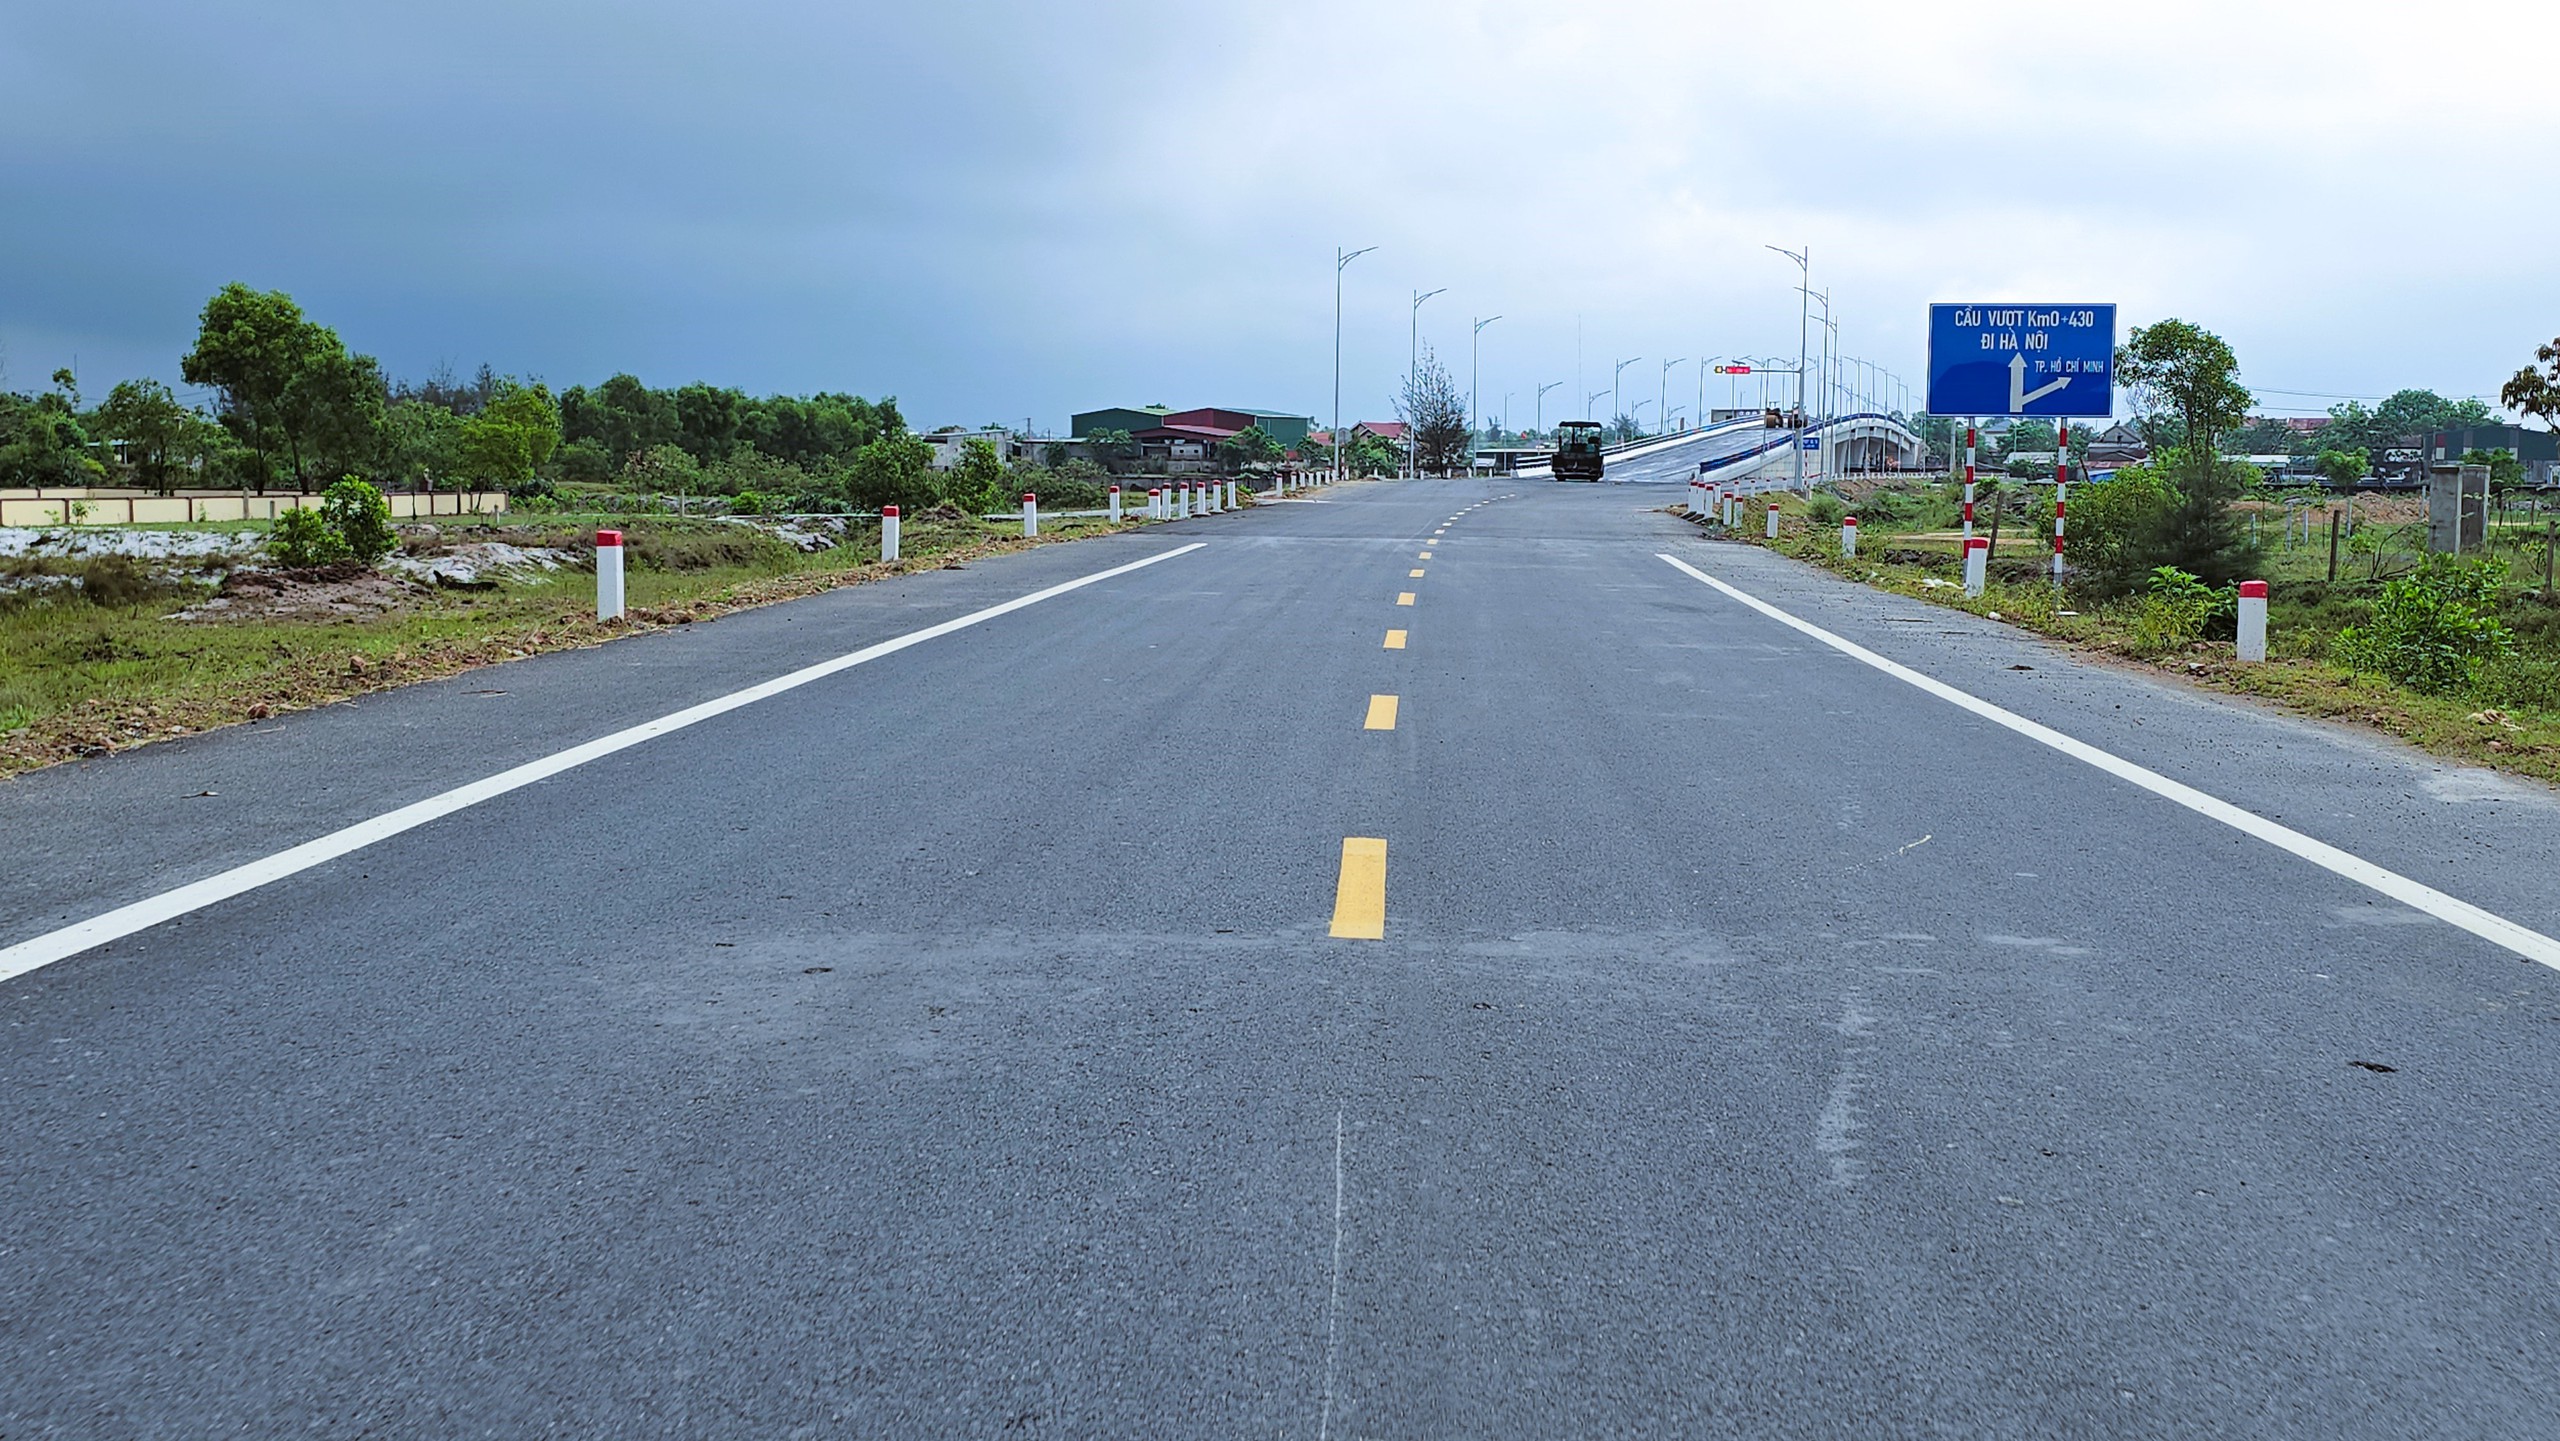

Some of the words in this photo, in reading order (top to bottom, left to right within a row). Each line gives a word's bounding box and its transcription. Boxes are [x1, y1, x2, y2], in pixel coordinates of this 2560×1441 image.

[1955, 305, 1981, 326] CẦU
[1988, 310, 2024, 329] VƯỢT
[1981, 333, 1995, 349] ĐI
[2000, 329, 2018, 349] HÀ
[2025, 330, 2048, 352] NỘI
[2035, 360, 2047, 373] TP.
[2065, 356, 2080, 373] CHÍ
[2083, 360, 2104, 373] MINH
